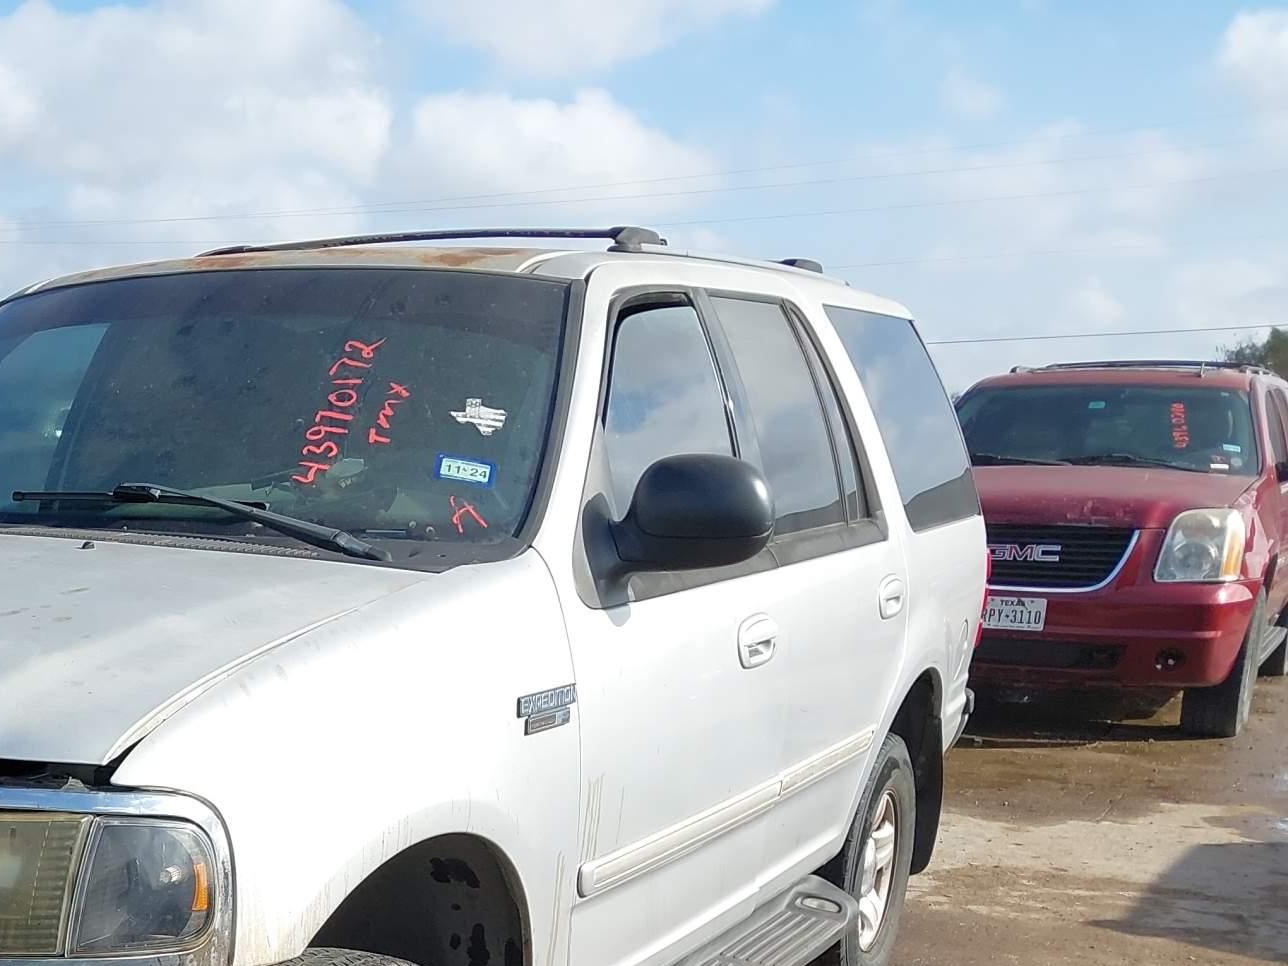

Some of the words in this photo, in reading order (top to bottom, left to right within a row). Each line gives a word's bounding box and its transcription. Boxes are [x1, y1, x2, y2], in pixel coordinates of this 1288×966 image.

[291, 336, 388, 484] 43970172
[986, 543, 1062, 562] GMC
[519, 685, 577, 716] EXPEDITION
